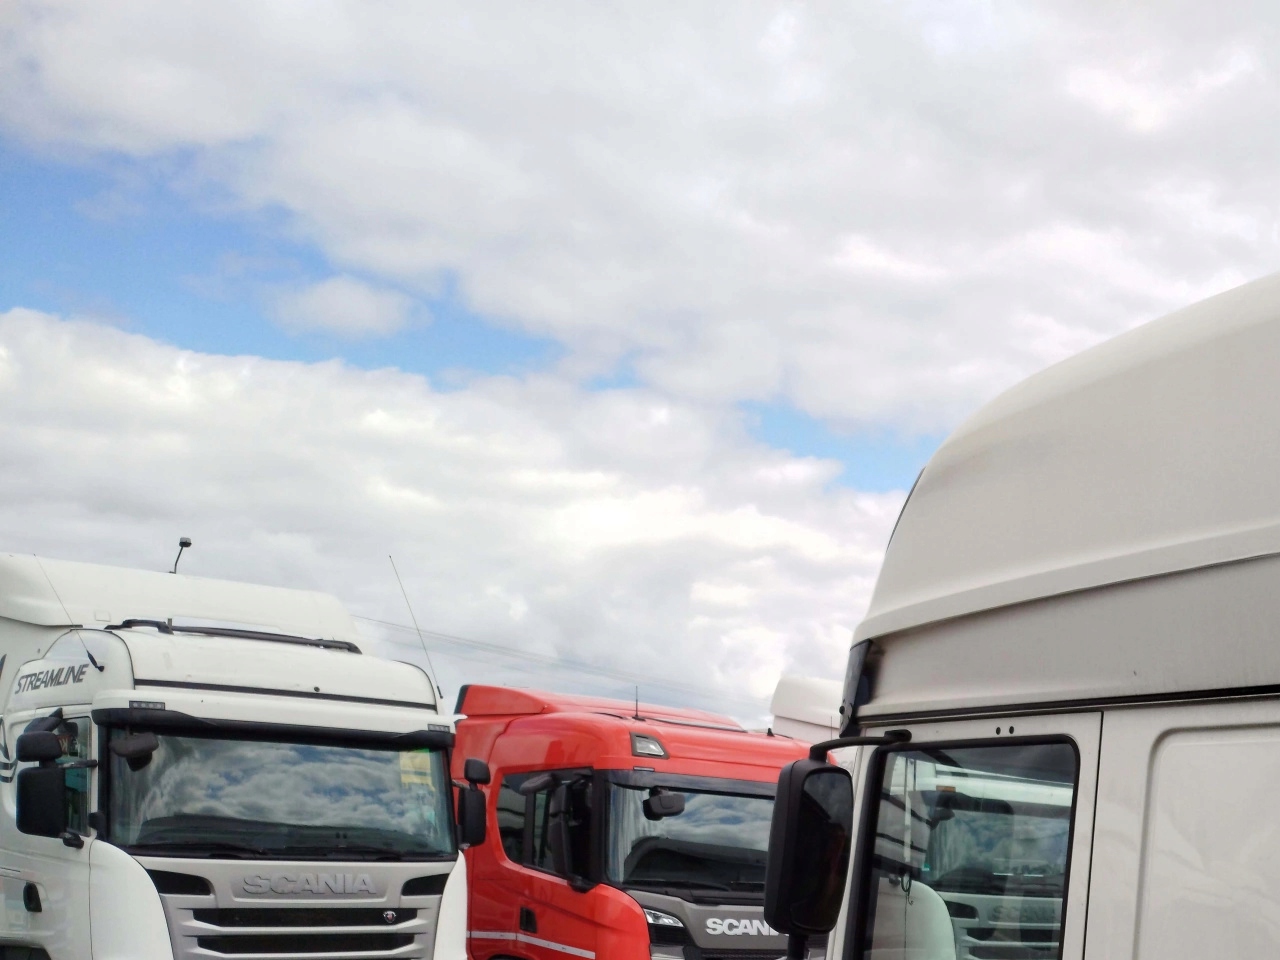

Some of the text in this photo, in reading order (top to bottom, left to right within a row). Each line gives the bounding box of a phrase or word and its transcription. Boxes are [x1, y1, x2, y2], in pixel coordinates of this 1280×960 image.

[15, 663, 89, 694] STREAMLINE
[243, 873, 377, 895] SCANIA
[705, 917, 790, 936] SCAN
